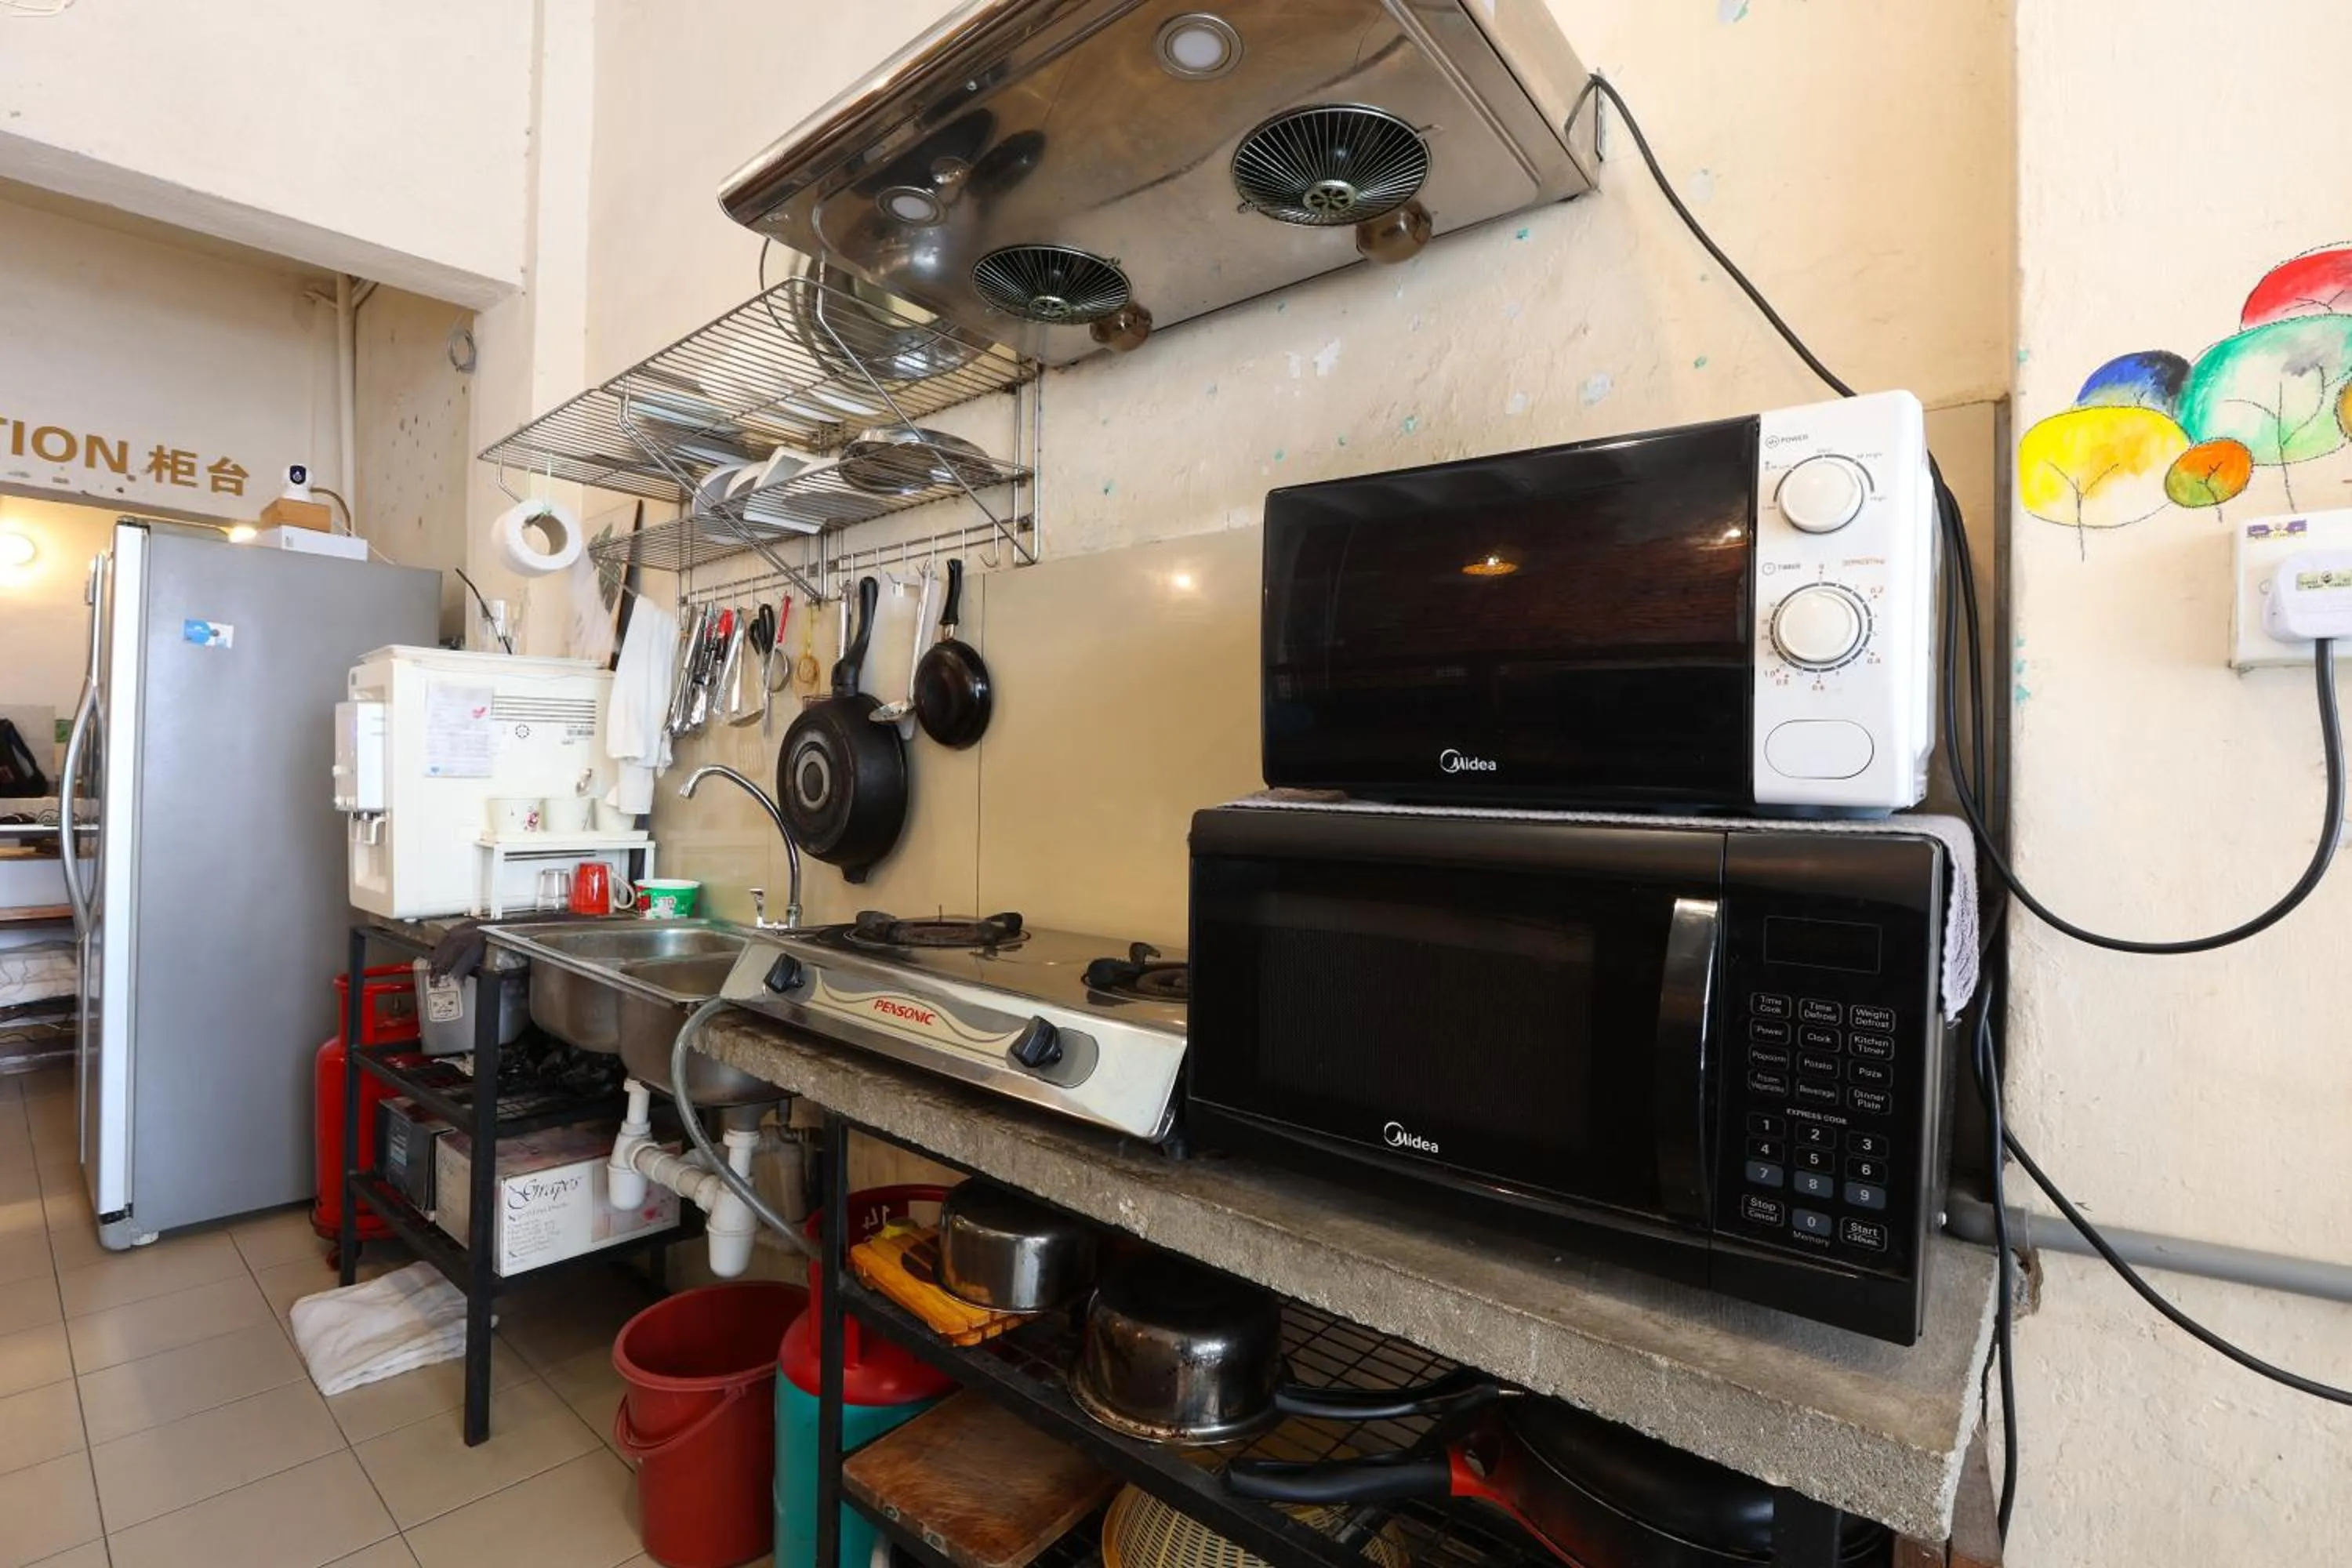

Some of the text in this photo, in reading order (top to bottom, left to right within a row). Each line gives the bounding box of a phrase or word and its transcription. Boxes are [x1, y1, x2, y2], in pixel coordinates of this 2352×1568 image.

[147, 445, 250, 496] 柜台
[1441, 750, 1497, 772] Midea
[874, 1000, 935, 1025] PENSONIC
[1856, 1008, 1889, 1020] Weight
[1807, 1033, 1832, 1044] Clock
[1854, 1036, 1889, 1047] Kitchen
[1858, 1067, 1882, 1078] Pizza
[1853, 1089, 1886, 1101] Dinner
[1762, 1120, 1769, 1131] 1
[1384, 1122, 1439, 1153] Midea
[1810, 1128, 1820, 1141] 2
[1761, 1144, 1769, 1155] 4
[1862, 1138, 1872, 1150] 3
[1810, 1153, 1819, 1164] 5
[1760, 1167, 1768, 1178] 7
[1861, 1164, 1871, 1175] 6
[1809, 1178, 1818, 1189] 8
[1860, 1190, 1869, 1201] 9
[1750, 1198, 1776, 1211] Stop
[1807, 1217, 1816, 1228] 0
[1850, 1222, 1878, 1236] Start
